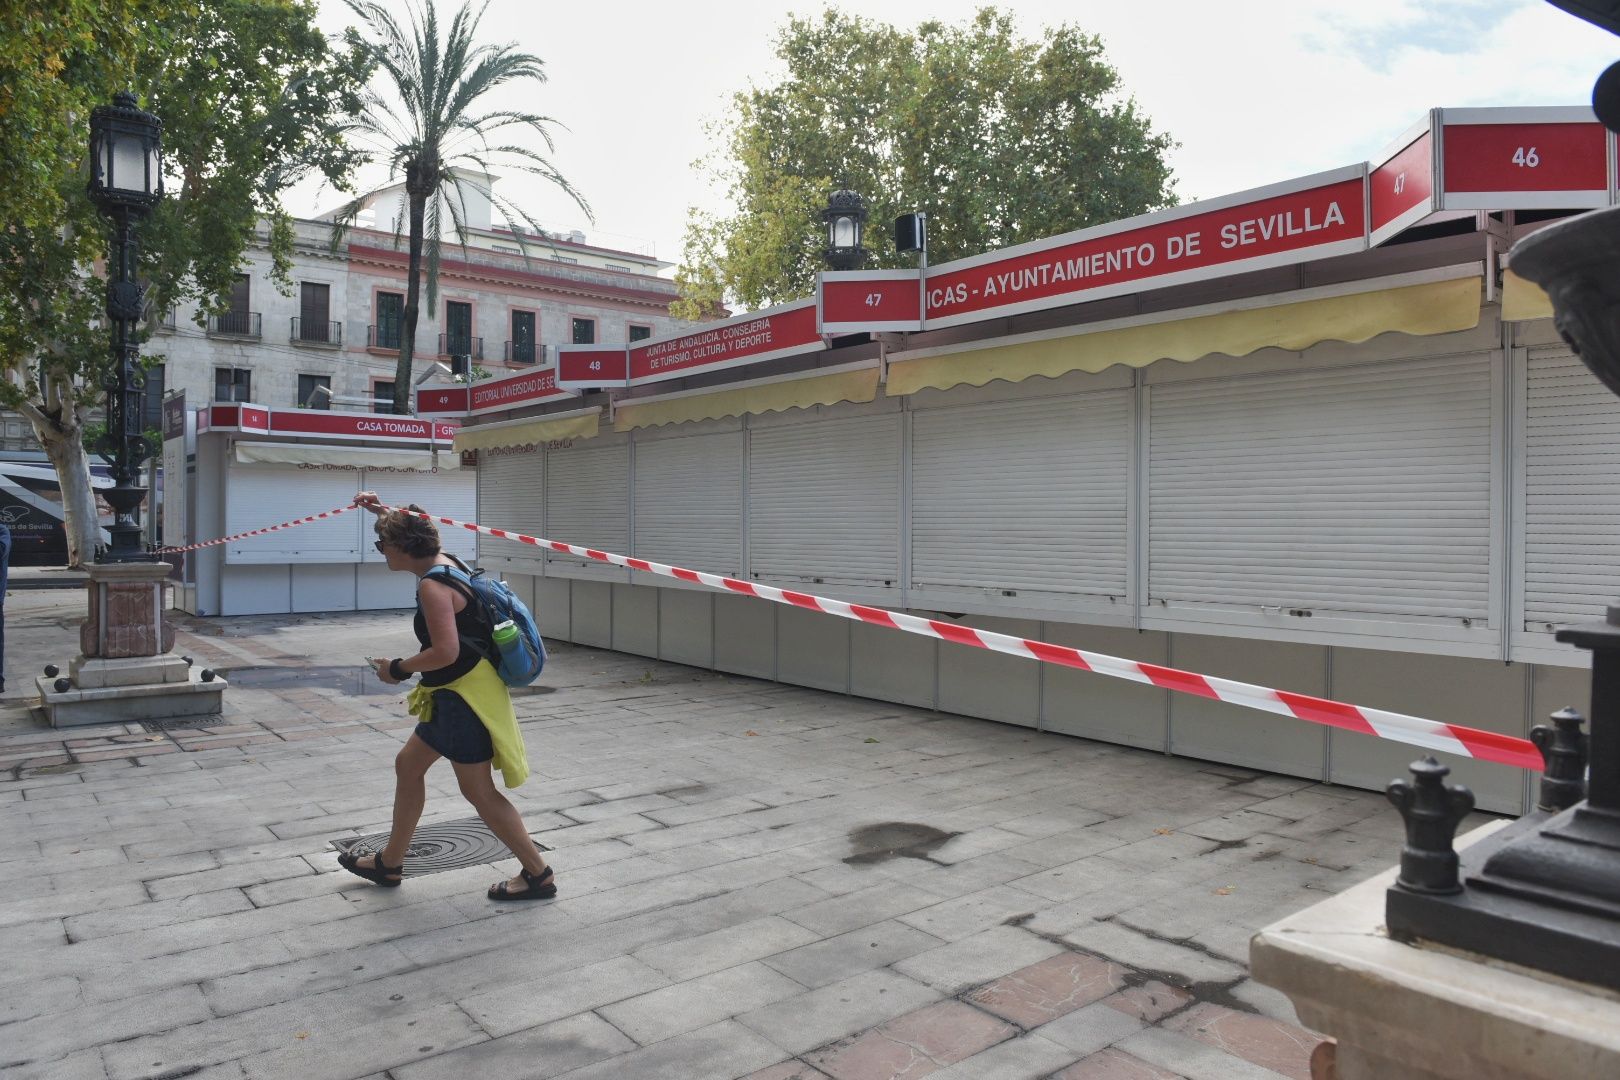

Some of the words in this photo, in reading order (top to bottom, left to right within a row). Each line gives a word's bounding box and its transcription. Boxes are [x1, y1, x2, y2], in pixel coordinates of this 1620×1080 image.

[1511, 147, 1539, 168] 46
[1394, 172, 1405, 195] 47
[926, 282, 967, 309] ICAS
[984, 243, 1155, 297] AYUNTAMIENTO
[1167, 232, 1201, 260] DE
[1220, 201, 1345, 249] SEVILLA
[865, 293, 882, 307] 47
[646, 344, 667, 357] JUNTA
[668, 341, 677, 352] DE
[650, 358, 660, 369] DE
[693, 343, 726, 359] CULTURA
[728, 340, 734, 351] Y
[736, 332, 772, 350] DEPORTE
[589, 360, 601, 371] 48
[501, 379, 537, 399] UNIVERSIDAD
[537, 378, 546, 391] DE
[439, 396, 449, 404] 49
[357, 421, 382, 431] CASA
[384, 423, 425, 434] TOMADA
